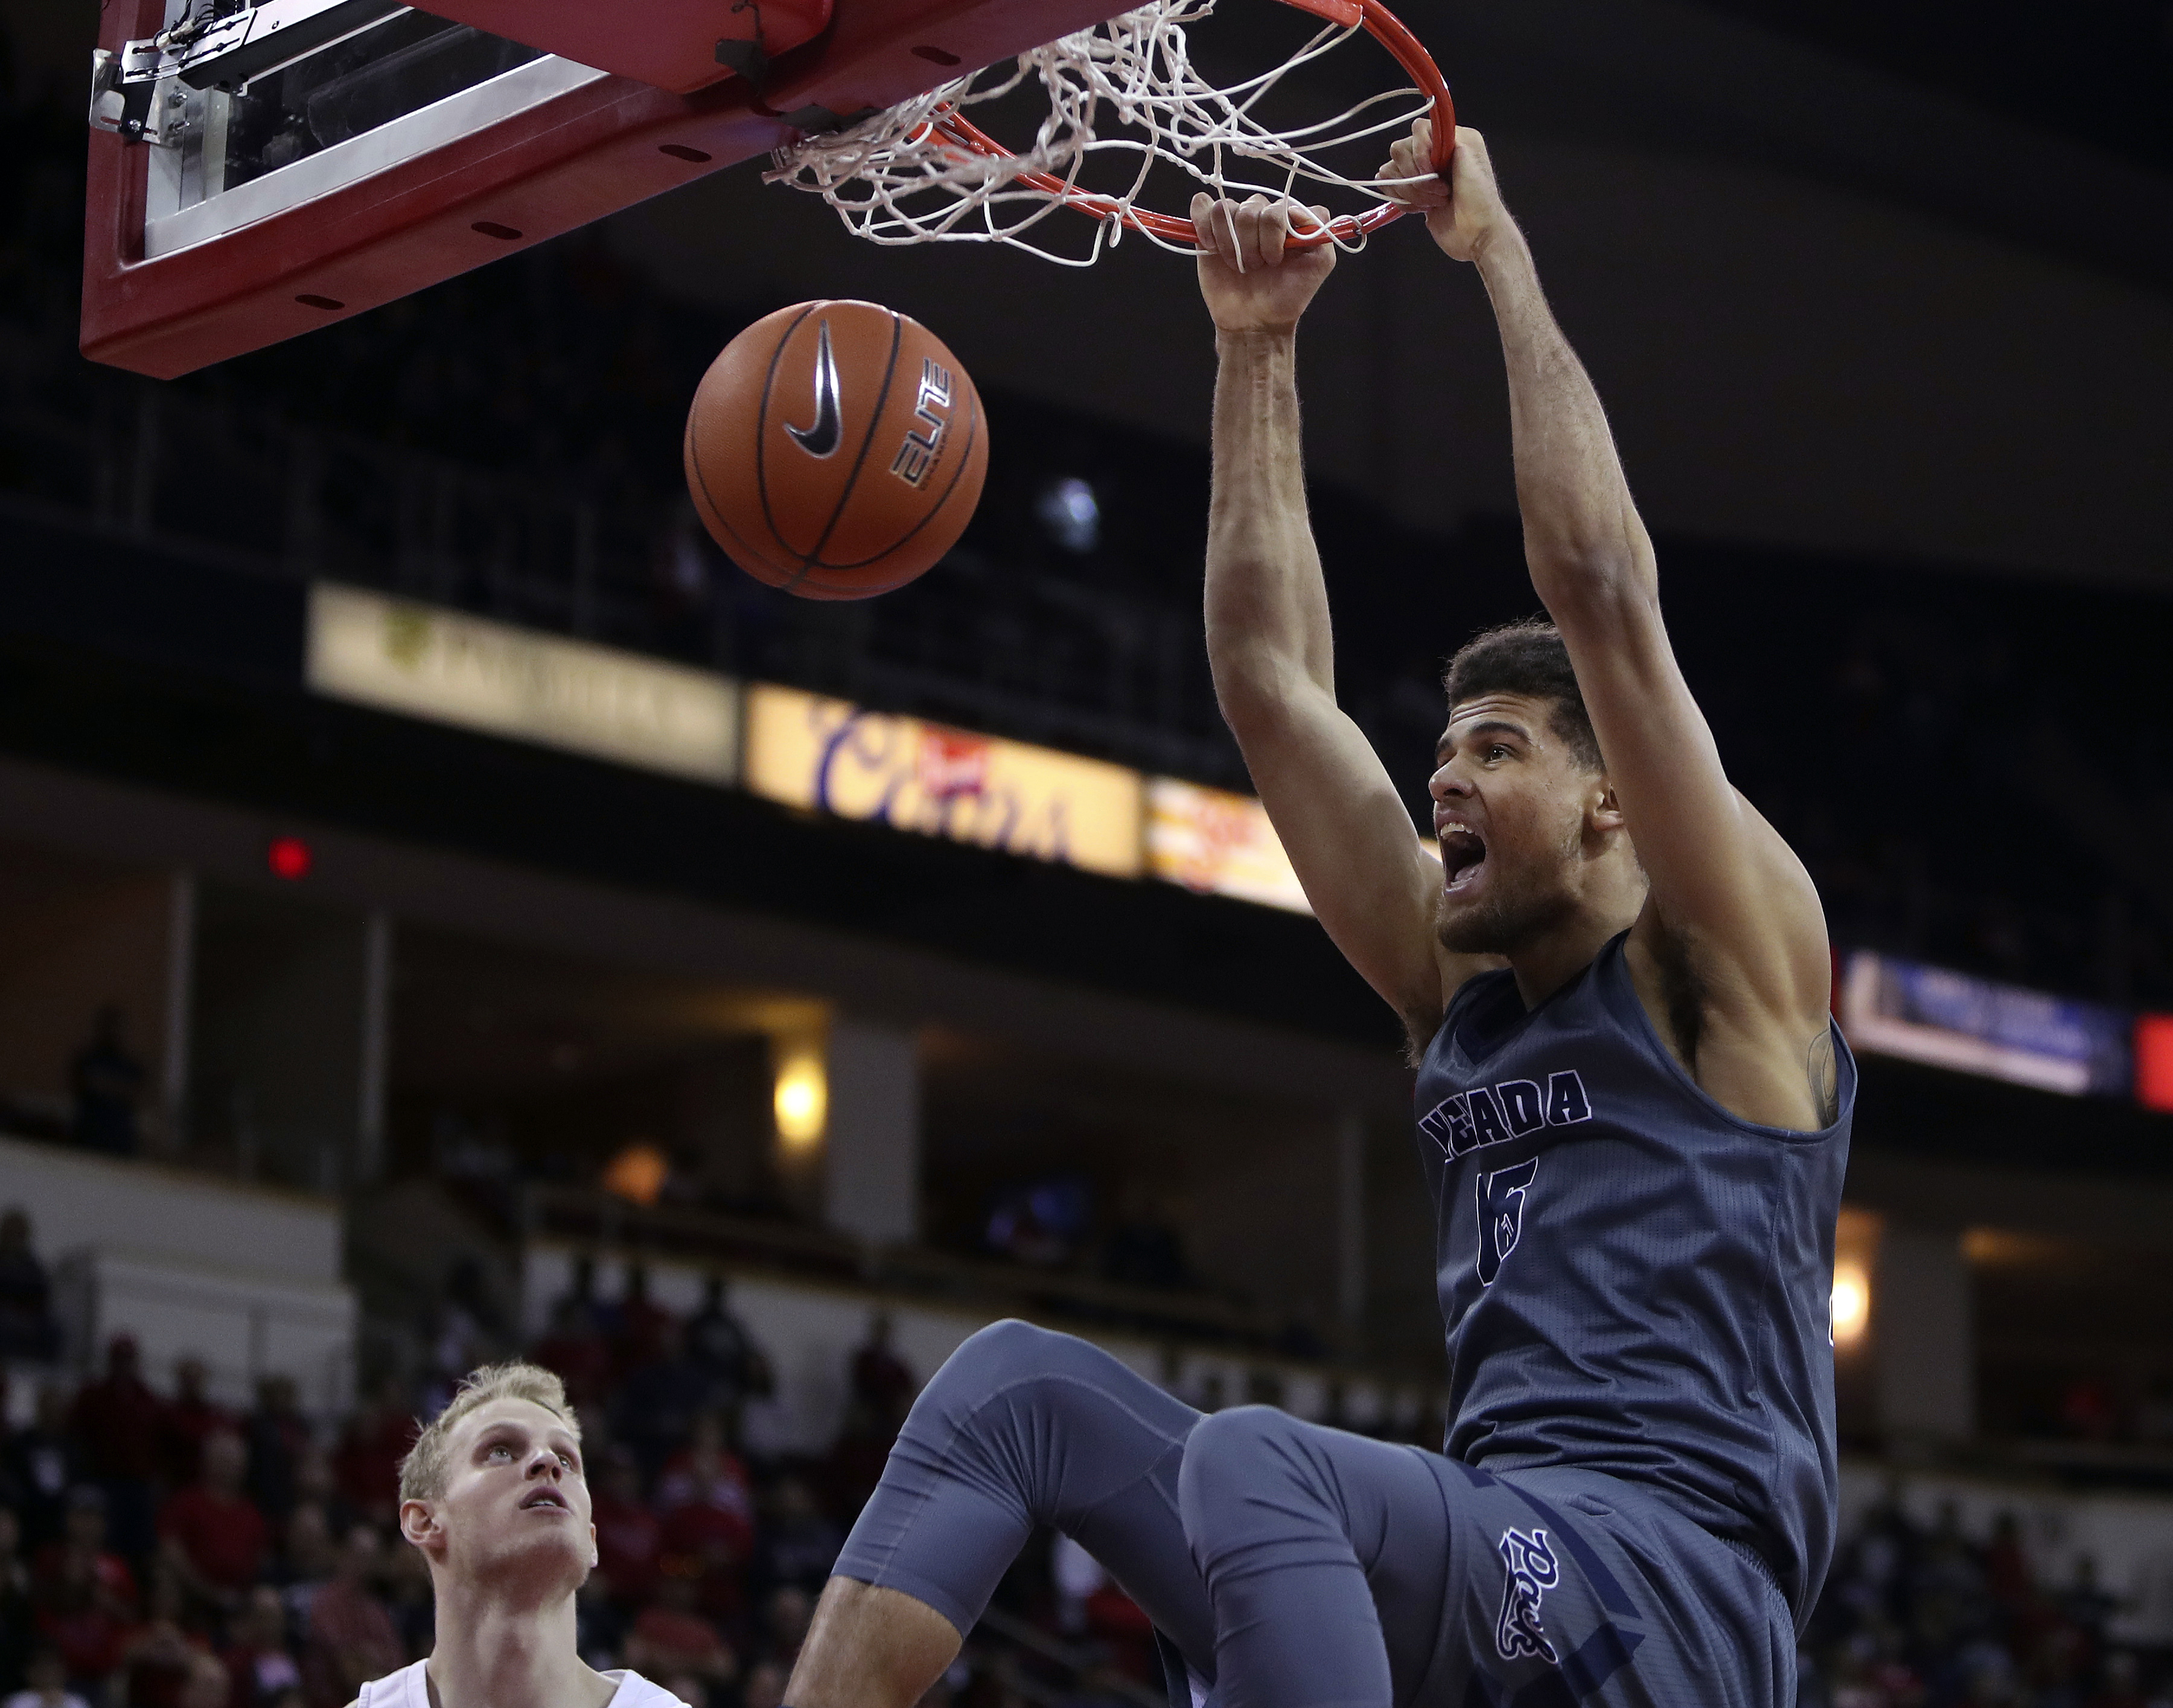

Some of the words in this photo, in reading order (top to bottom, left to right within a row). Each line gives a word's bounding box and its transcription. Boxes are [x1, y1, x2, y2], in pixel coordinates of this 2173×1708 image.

[889, 357, 949, 488] ELITE
[1418, 1069, 1592, 1163] NEADA
[1496, 1526, 1559, 1665] Pack
